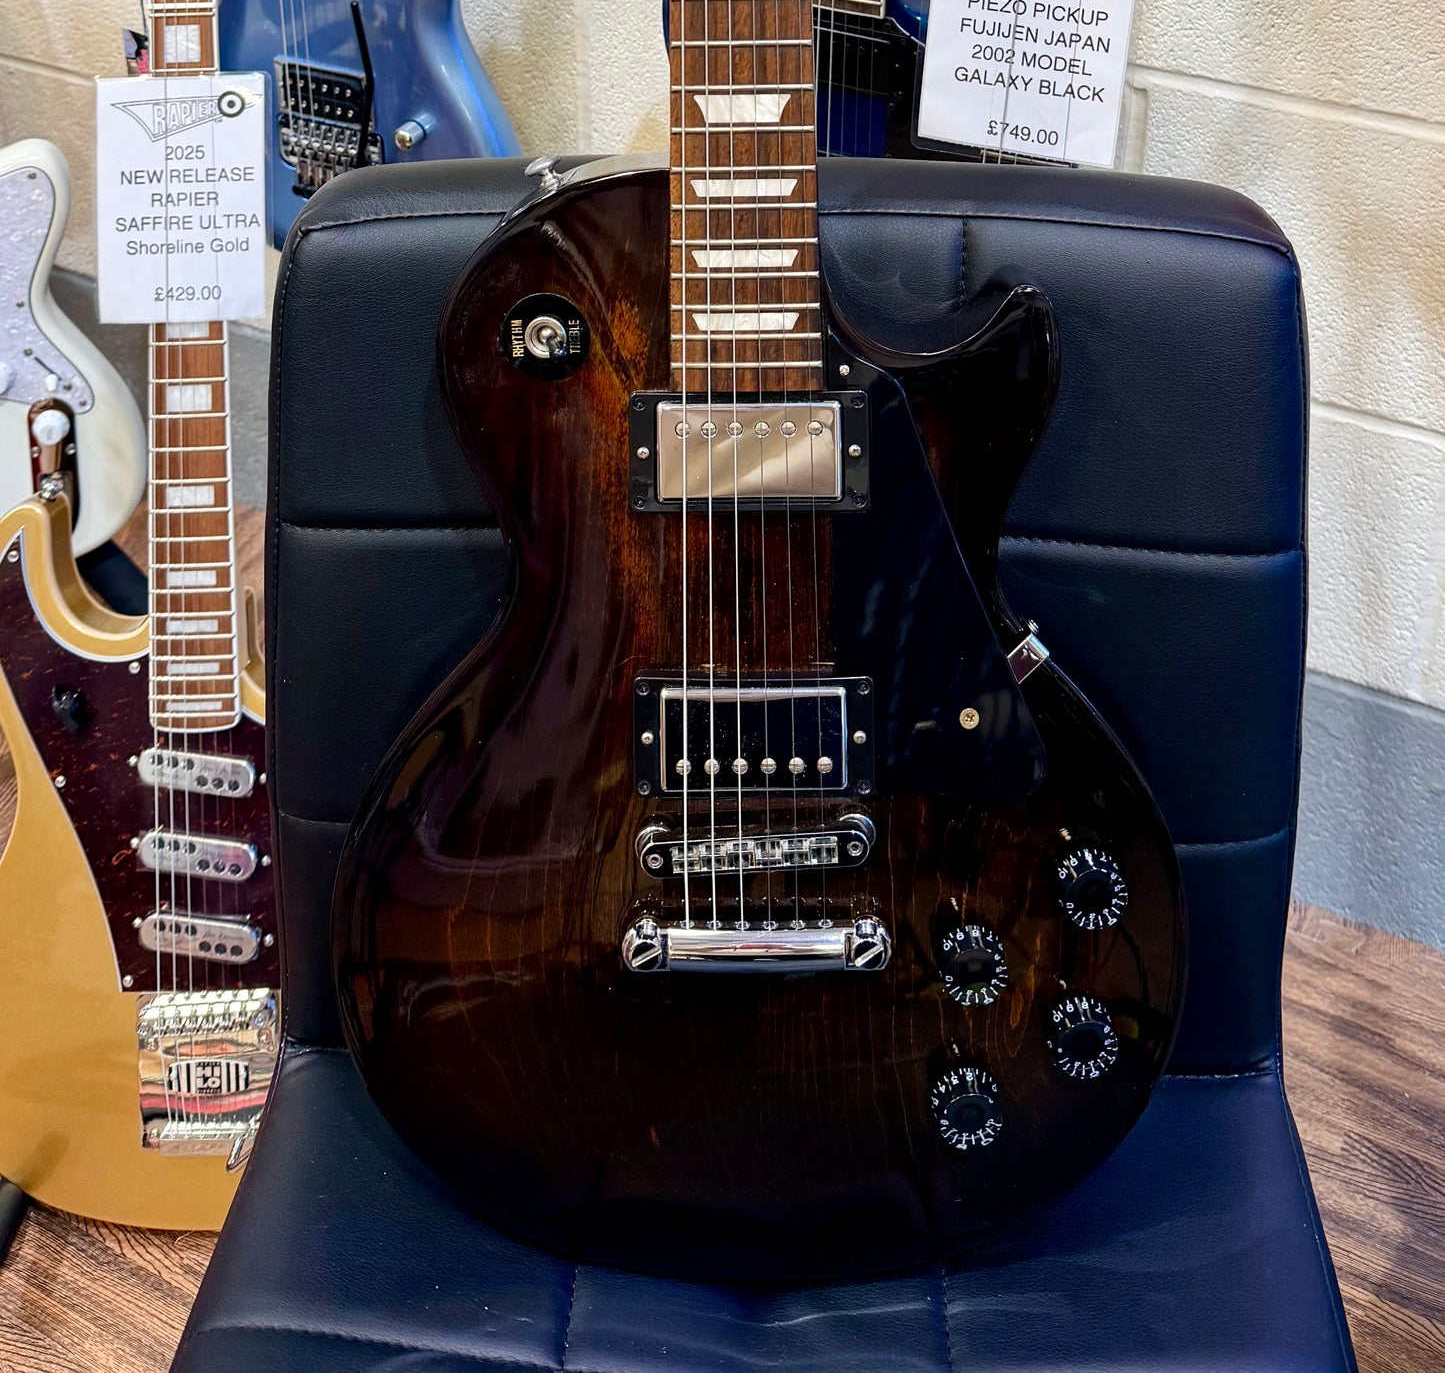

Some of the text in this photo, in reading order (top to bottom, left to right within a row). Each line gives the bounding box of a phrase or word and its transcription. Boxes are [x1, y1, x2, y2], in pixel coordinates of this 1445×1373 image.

[1033, 2, 1109, 26] PICKUP
[960, 18, 1111, 53] FUJIJEN JAPAN
[971, 44, 1092, 76] 2002 MODEL
[954, 67, 1106, 102] GALAXY BLACK
[153, 101, 218, 135] RAPIER
[987, 120, 1059, 146] £749.00
[165, 145, 205, 161] 2025
[121, 167, 255, 185] NEW RELEASE
[151, 192, 219, 208] RAPIER
[115, 213, 261, 232] SAFFIRE ULTRA
[126, 237, 250, 256] Shoreline Gold
[154, 285, 222, 302] £429.00
[511, 320, 525, 357] RHYTHM
[568, 320, 581, 354] TREBLE
[197, 1066, 221, 1077] HI
[197, 1077, 221, 1088] LO
